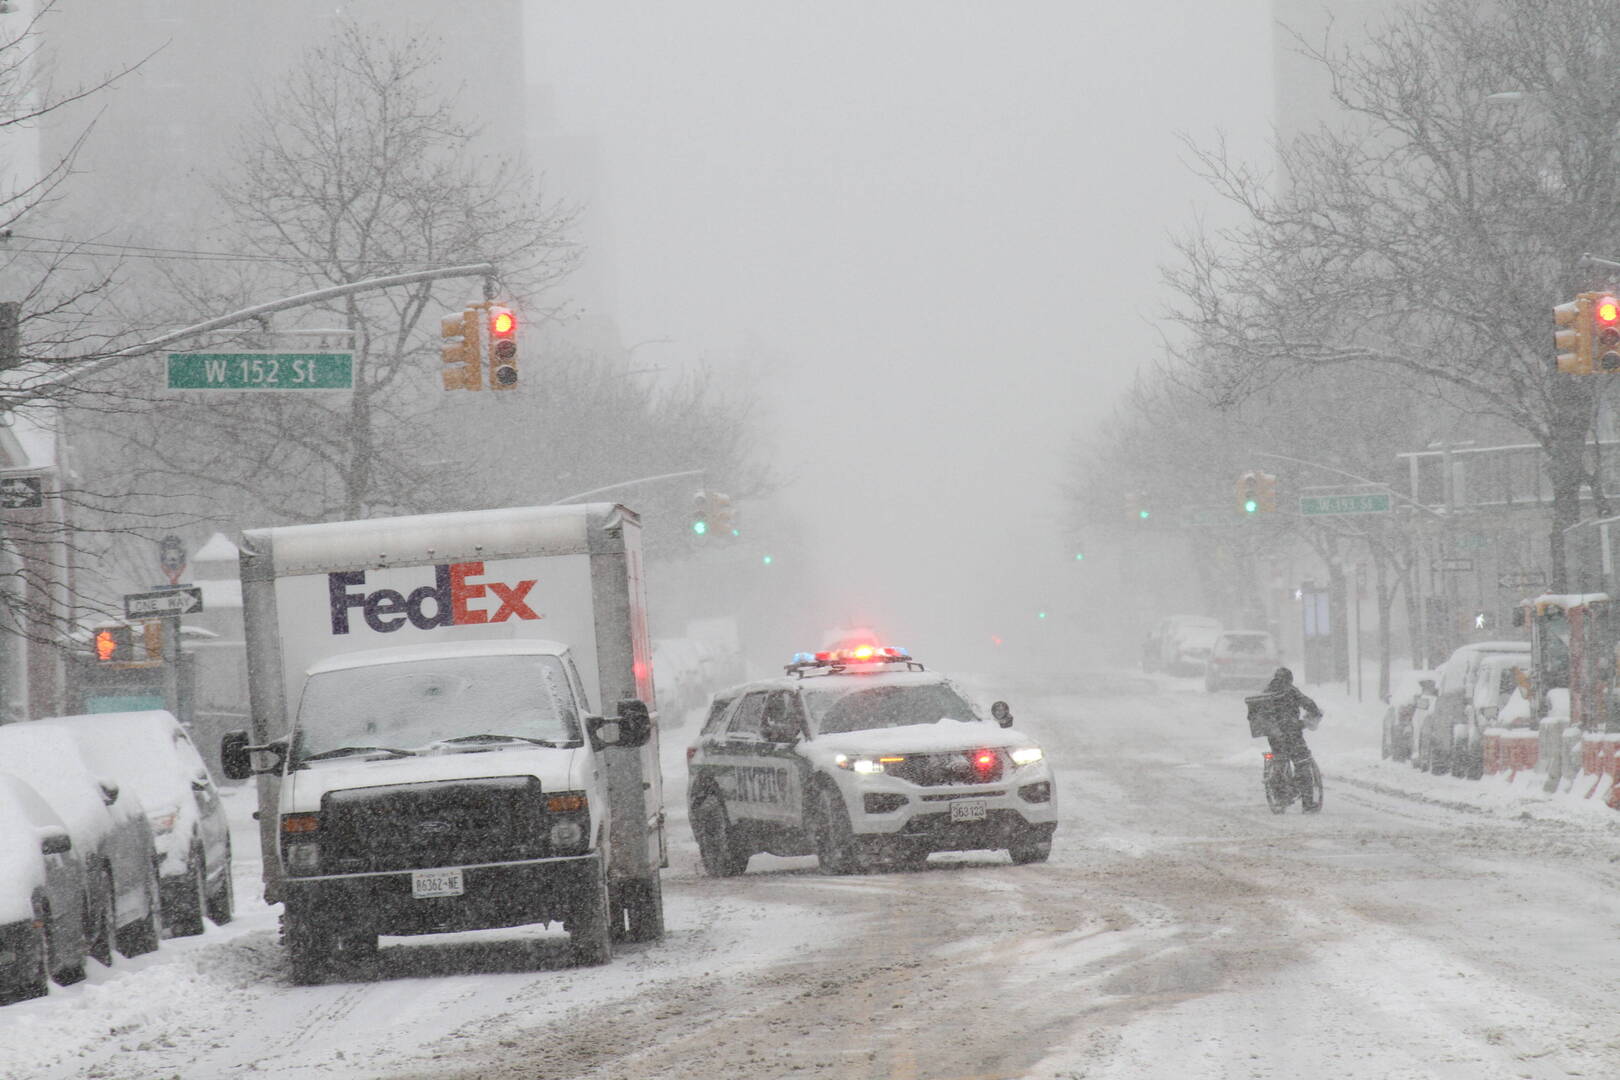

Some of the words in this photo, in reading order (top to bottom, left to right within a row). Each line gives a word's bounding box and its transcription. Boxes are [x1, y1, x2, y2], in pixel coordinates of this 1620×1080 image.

[204, 359, 227, 383] W
[240, 360, 280, 383] 152
[292, 360, 317, 383] St
[1319, 499, 1330, 512] W
[135, 600, 158, 613] ONE
[168, 596, 189, 610] WAY
[328, 561, 542, 635] FedEx
